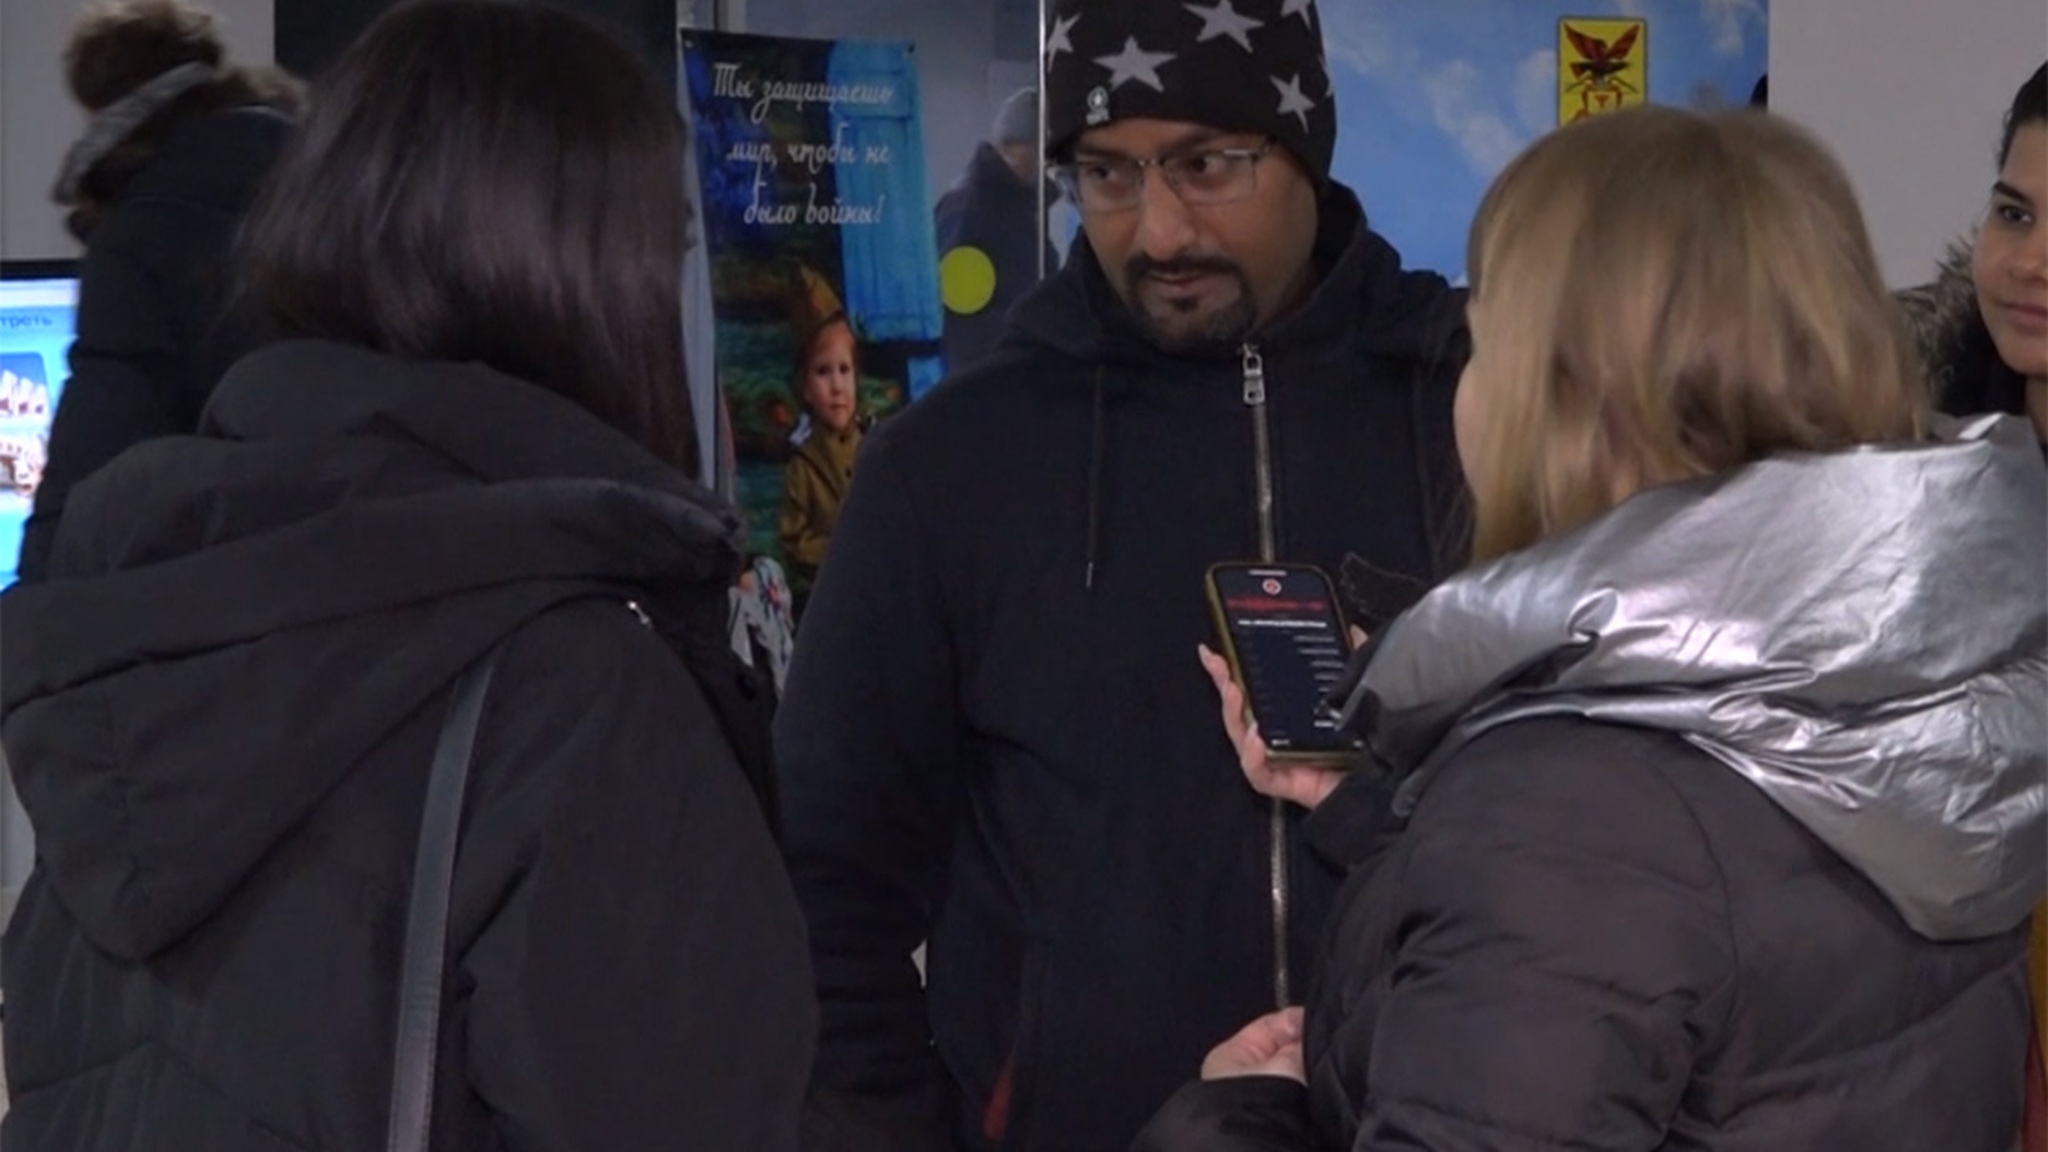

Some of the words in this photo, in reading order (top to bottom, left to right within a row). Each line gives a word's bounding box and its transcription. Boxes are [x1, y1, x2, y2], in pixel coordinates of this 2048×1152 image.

[713, 62, 753, 97] Ты
[751, 81, 893, 124] защищаешь
[726, 143, 778, 181] мир,
[787, 122, 856, 175] чтобы
[866, 144, 891, 164] не
[743, 181, 797, 224] было
[804, 182, 886, 224] войны!
